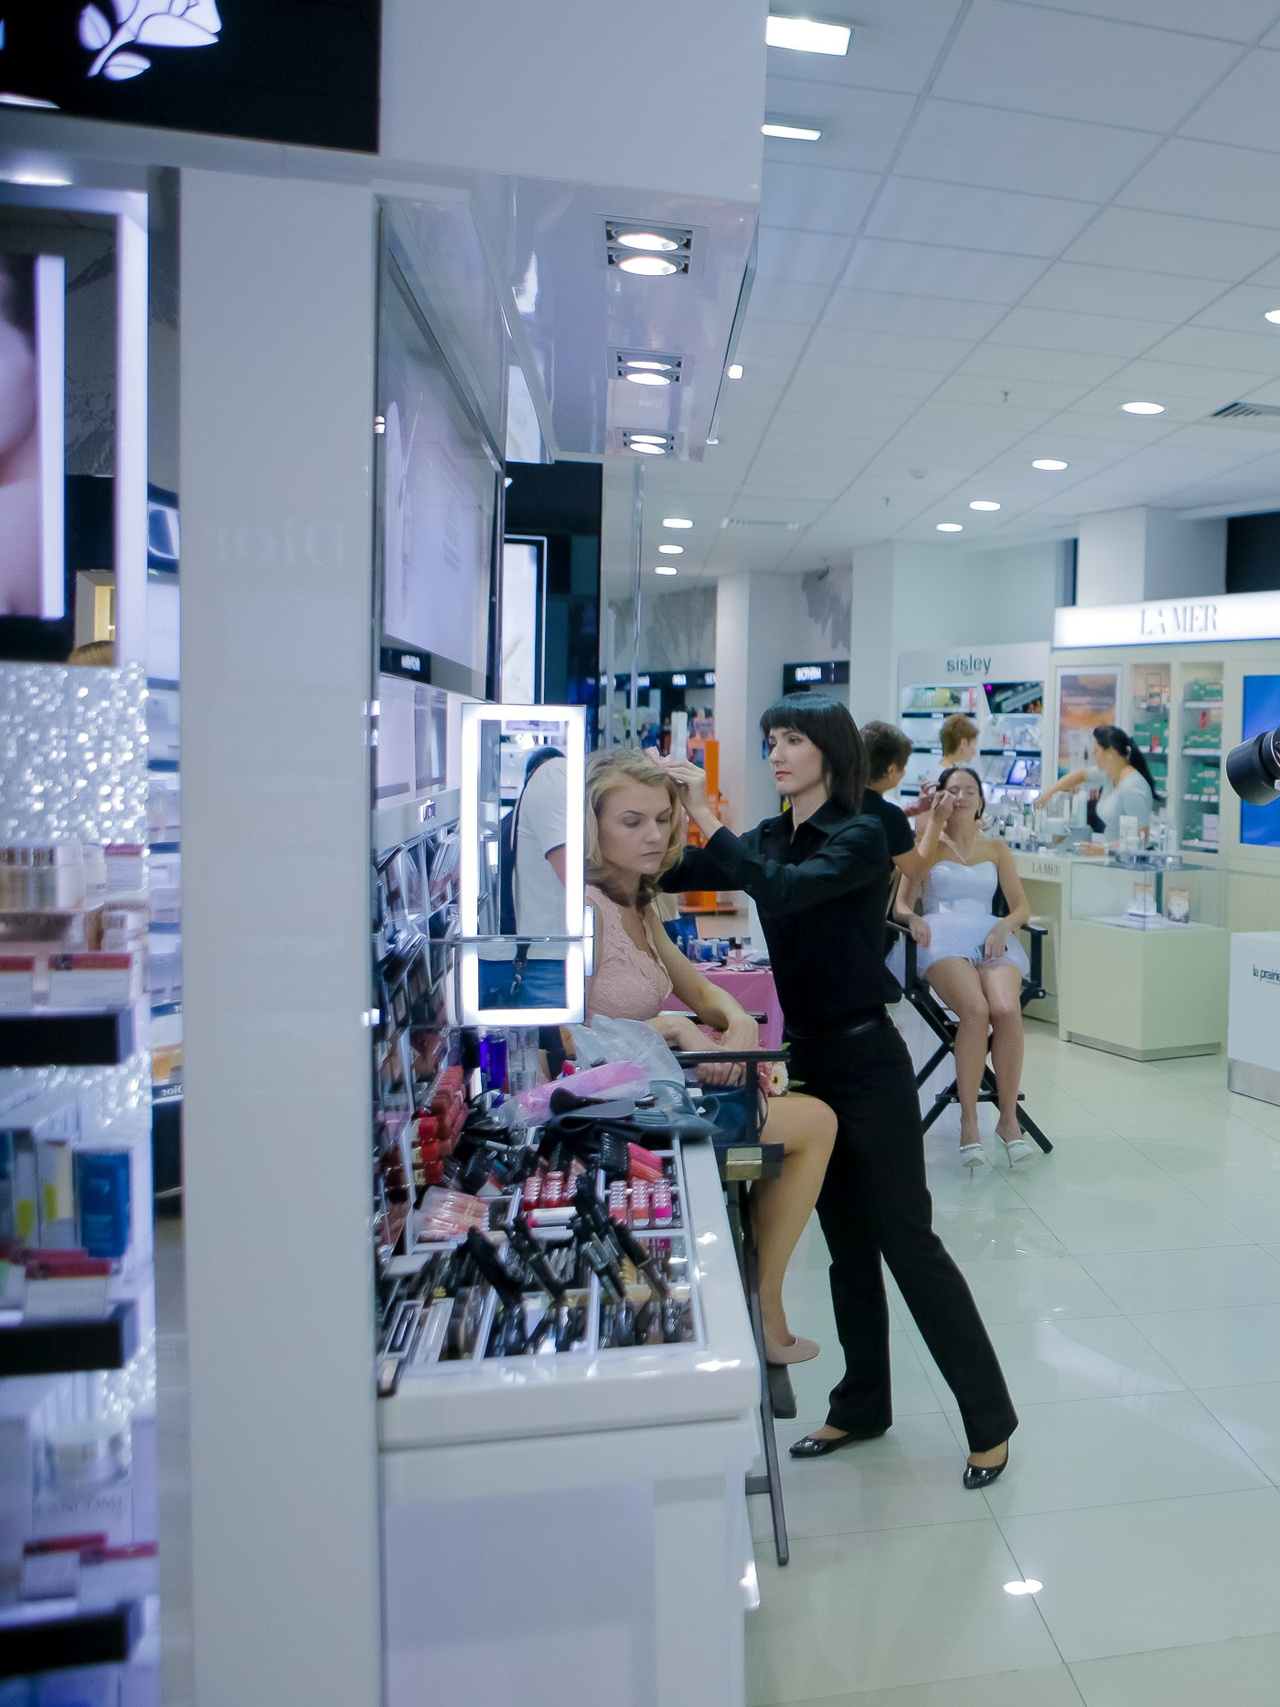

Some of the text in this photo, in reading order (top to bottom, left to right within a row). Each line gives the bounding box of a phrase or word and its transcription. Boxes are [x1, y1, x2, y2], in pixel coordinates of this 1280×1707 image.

[1140, 603, 1217, 635] LA MER
[947, 654, 992, 675] sisley
[1032, 861, 1061, 876] LA MER
[1253, 963, 1259, 977] la
